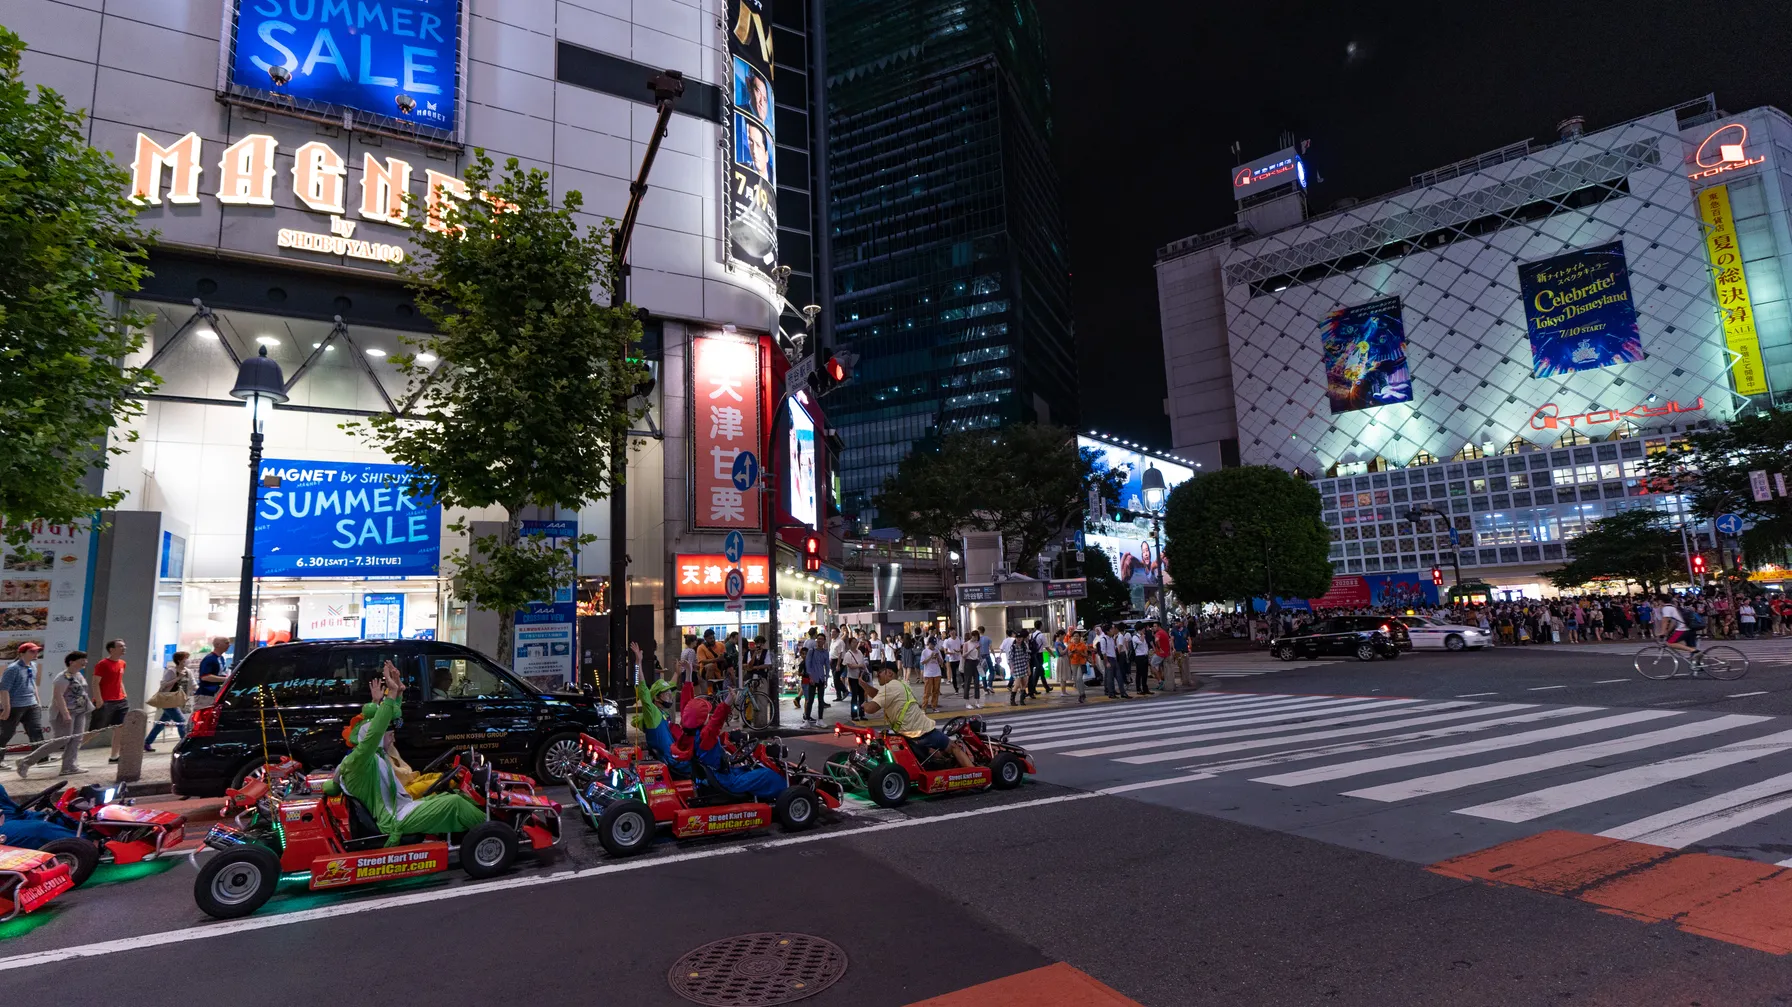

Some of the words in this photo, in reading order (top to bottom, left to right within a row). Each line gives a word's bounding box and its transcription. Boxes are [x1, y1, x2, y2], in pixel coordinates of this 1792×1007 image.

[253, 0, 444, 43] SUMMER
[249, 19, 444, 95] SALE
[416, 109, 446, 122] MAGNET
[1250, 163, 1295, 182] TOKYU
[1687, 154, 1766, 180] TOKYU
[129, 131, 521, 242] MAGNE
[330, 214, 356, 238] by
[1708, 192, 1725, 232] 東急百貨店
[276, 228, 404, 264] SHIBUYA109
[1534, 272, 1616, 313] Celebrate!
[1712, 234, 1748, 325] 夏の総決算
[1532, 314, 1565, 329] Tokyo
[1563, 290, 1628, 319] Disneyland
[1559, 327, 1580, 338] 7/10
[1581, 323, 1606, 334] START!
[1558, 396, 1704, 427] TOKYU
[709, 375, 745, 522] 天津甘栗
[260, 467, 338, 482] MAGNET
[340, 470, 357, 483] by
[260, 486, 417, 520] SUMMER
[332, 515, 429, 549] SALE
[681, 565, 765, 585] 天津栗
[708, 814, 729, 822] Street
[356, 859, 437, 878] MariCar.com
[357, 857, 386, 867] Street
[387, 854, 407, 864] Kart
[408, 852, 429, 861] Tour
